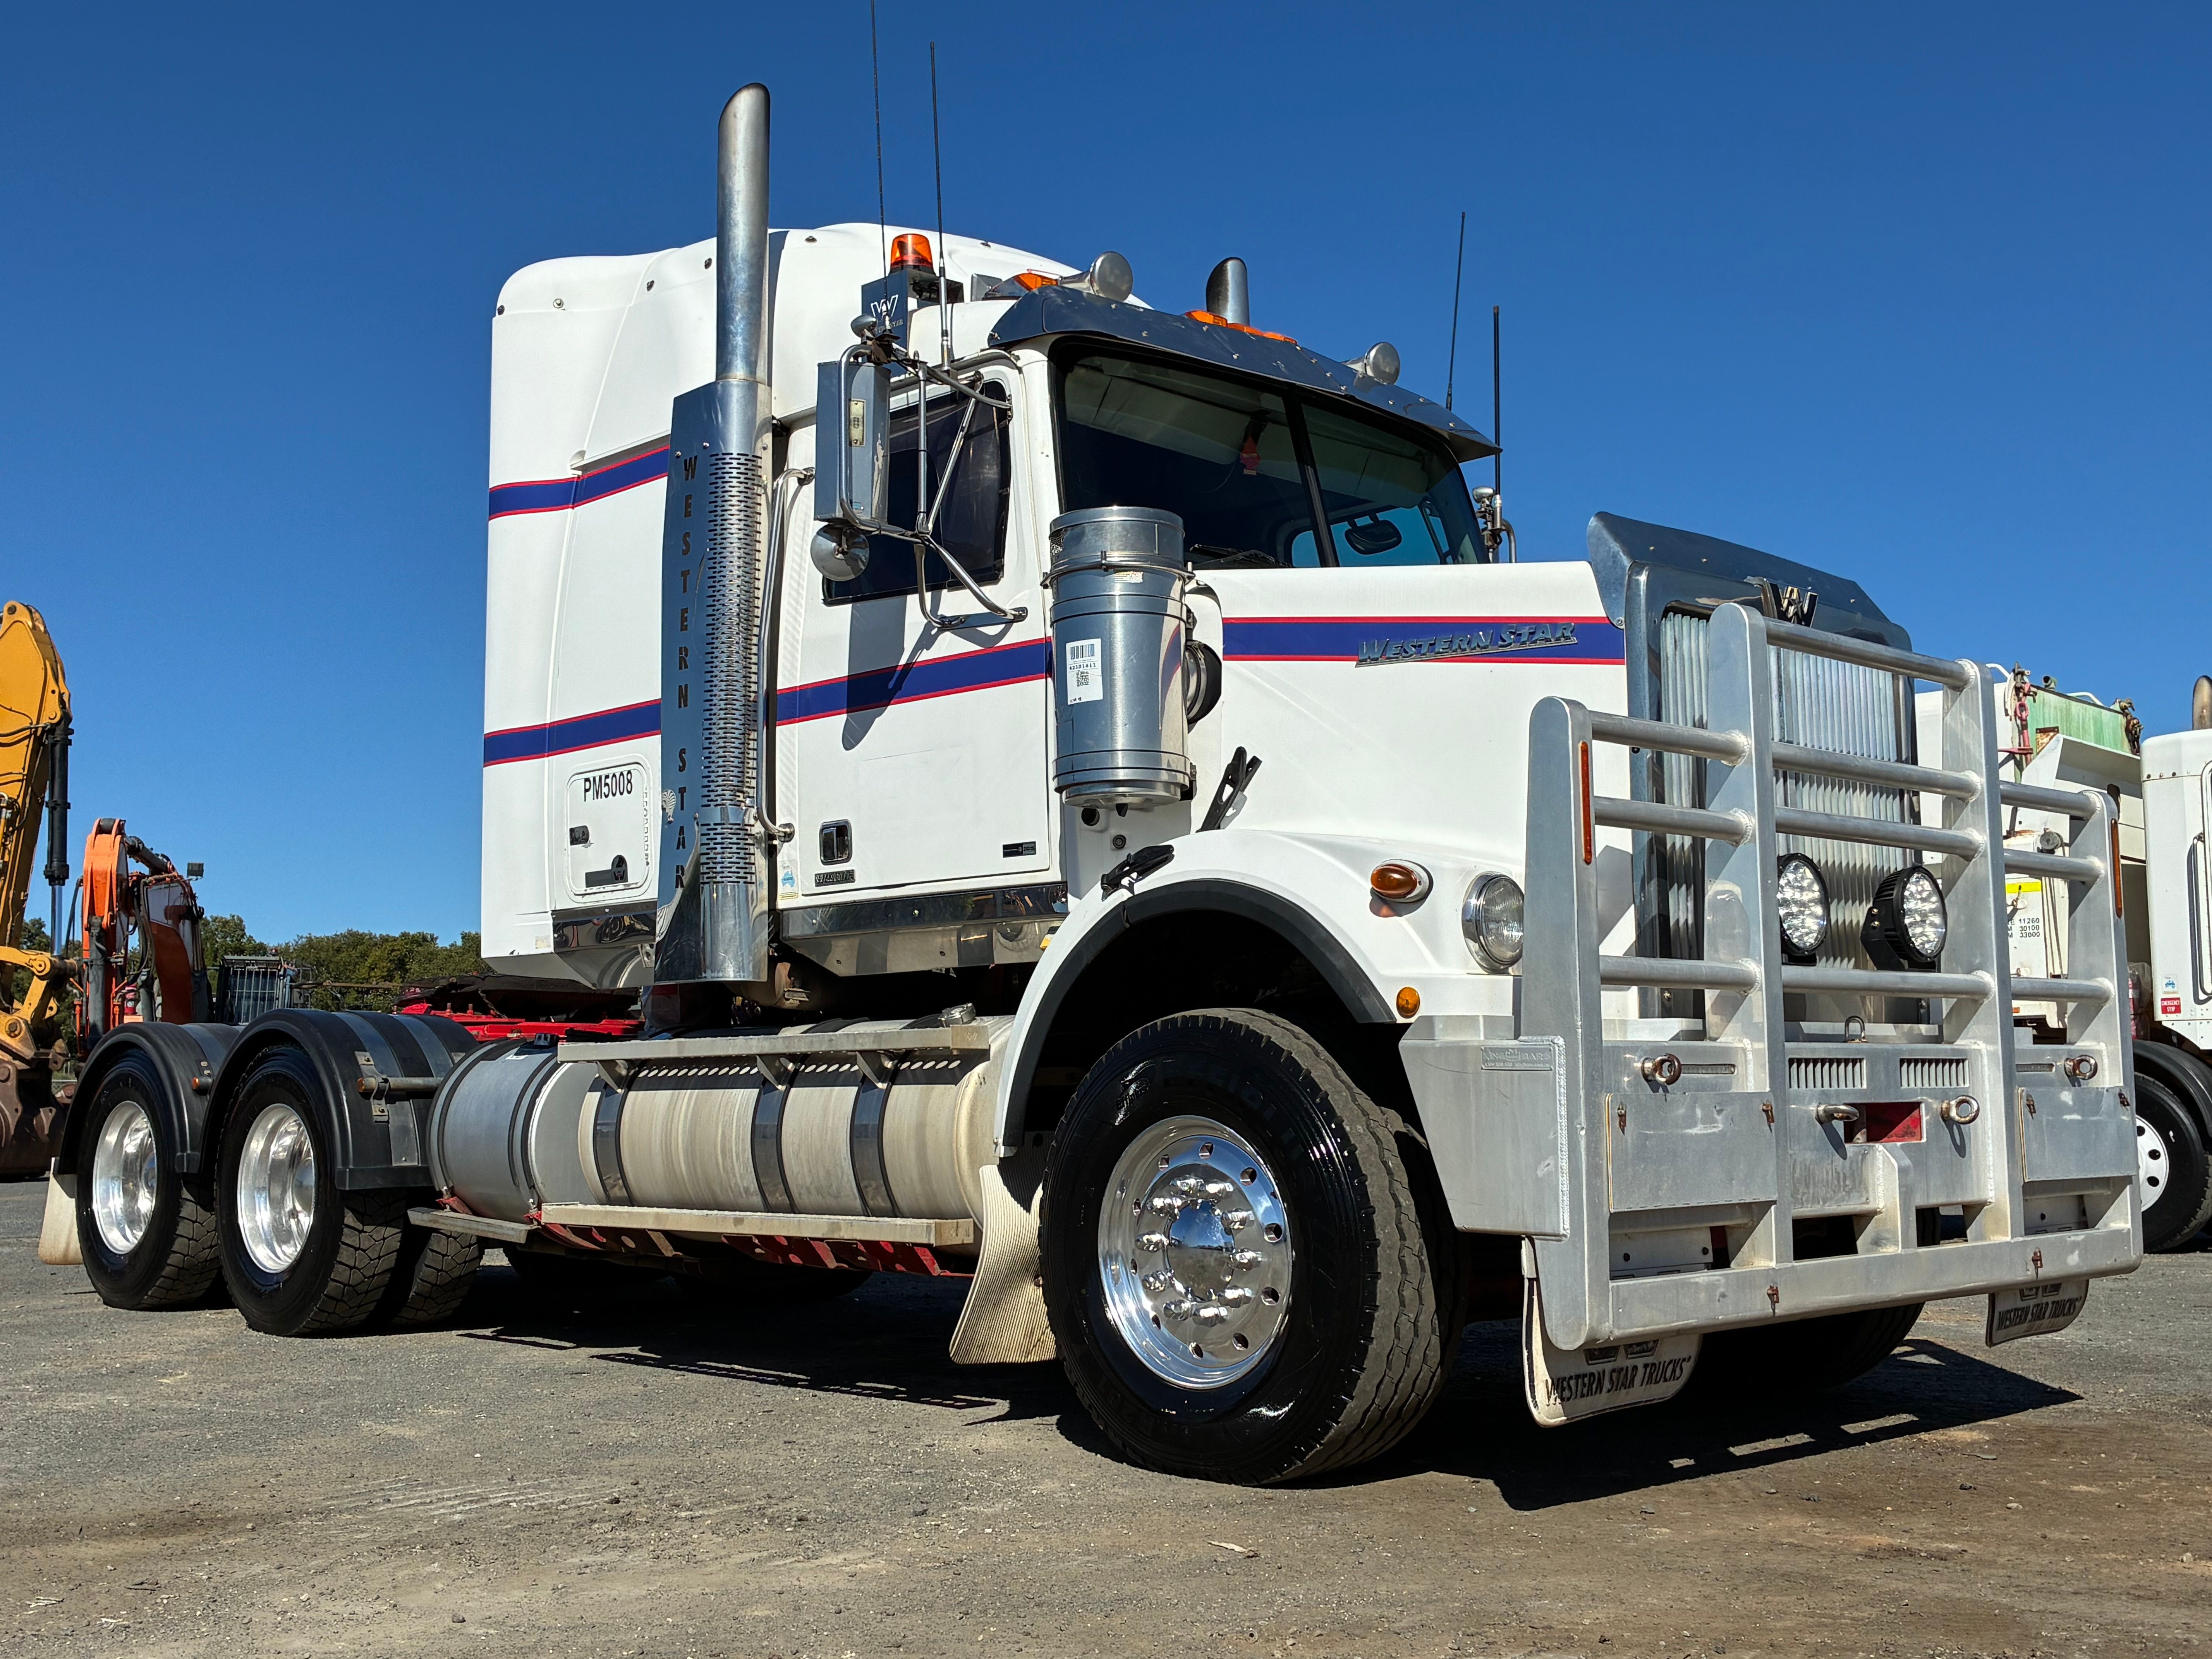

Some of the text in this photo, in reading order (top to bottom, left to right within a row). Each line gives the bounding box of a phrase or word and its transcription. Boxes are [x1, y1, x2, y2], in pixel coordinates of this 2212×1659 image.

[1357, 622, 1576, 663] WESTERN STAR
[674, 455, 698, 890] WESTERN STAR
[584, 770, 633, 802] PM5008
[1997, 1297, 2078, 1331] WESTERN STAR TRUCKS
[1545, 1357, 1686, 1405] WESTERN STAR TRUCKS
